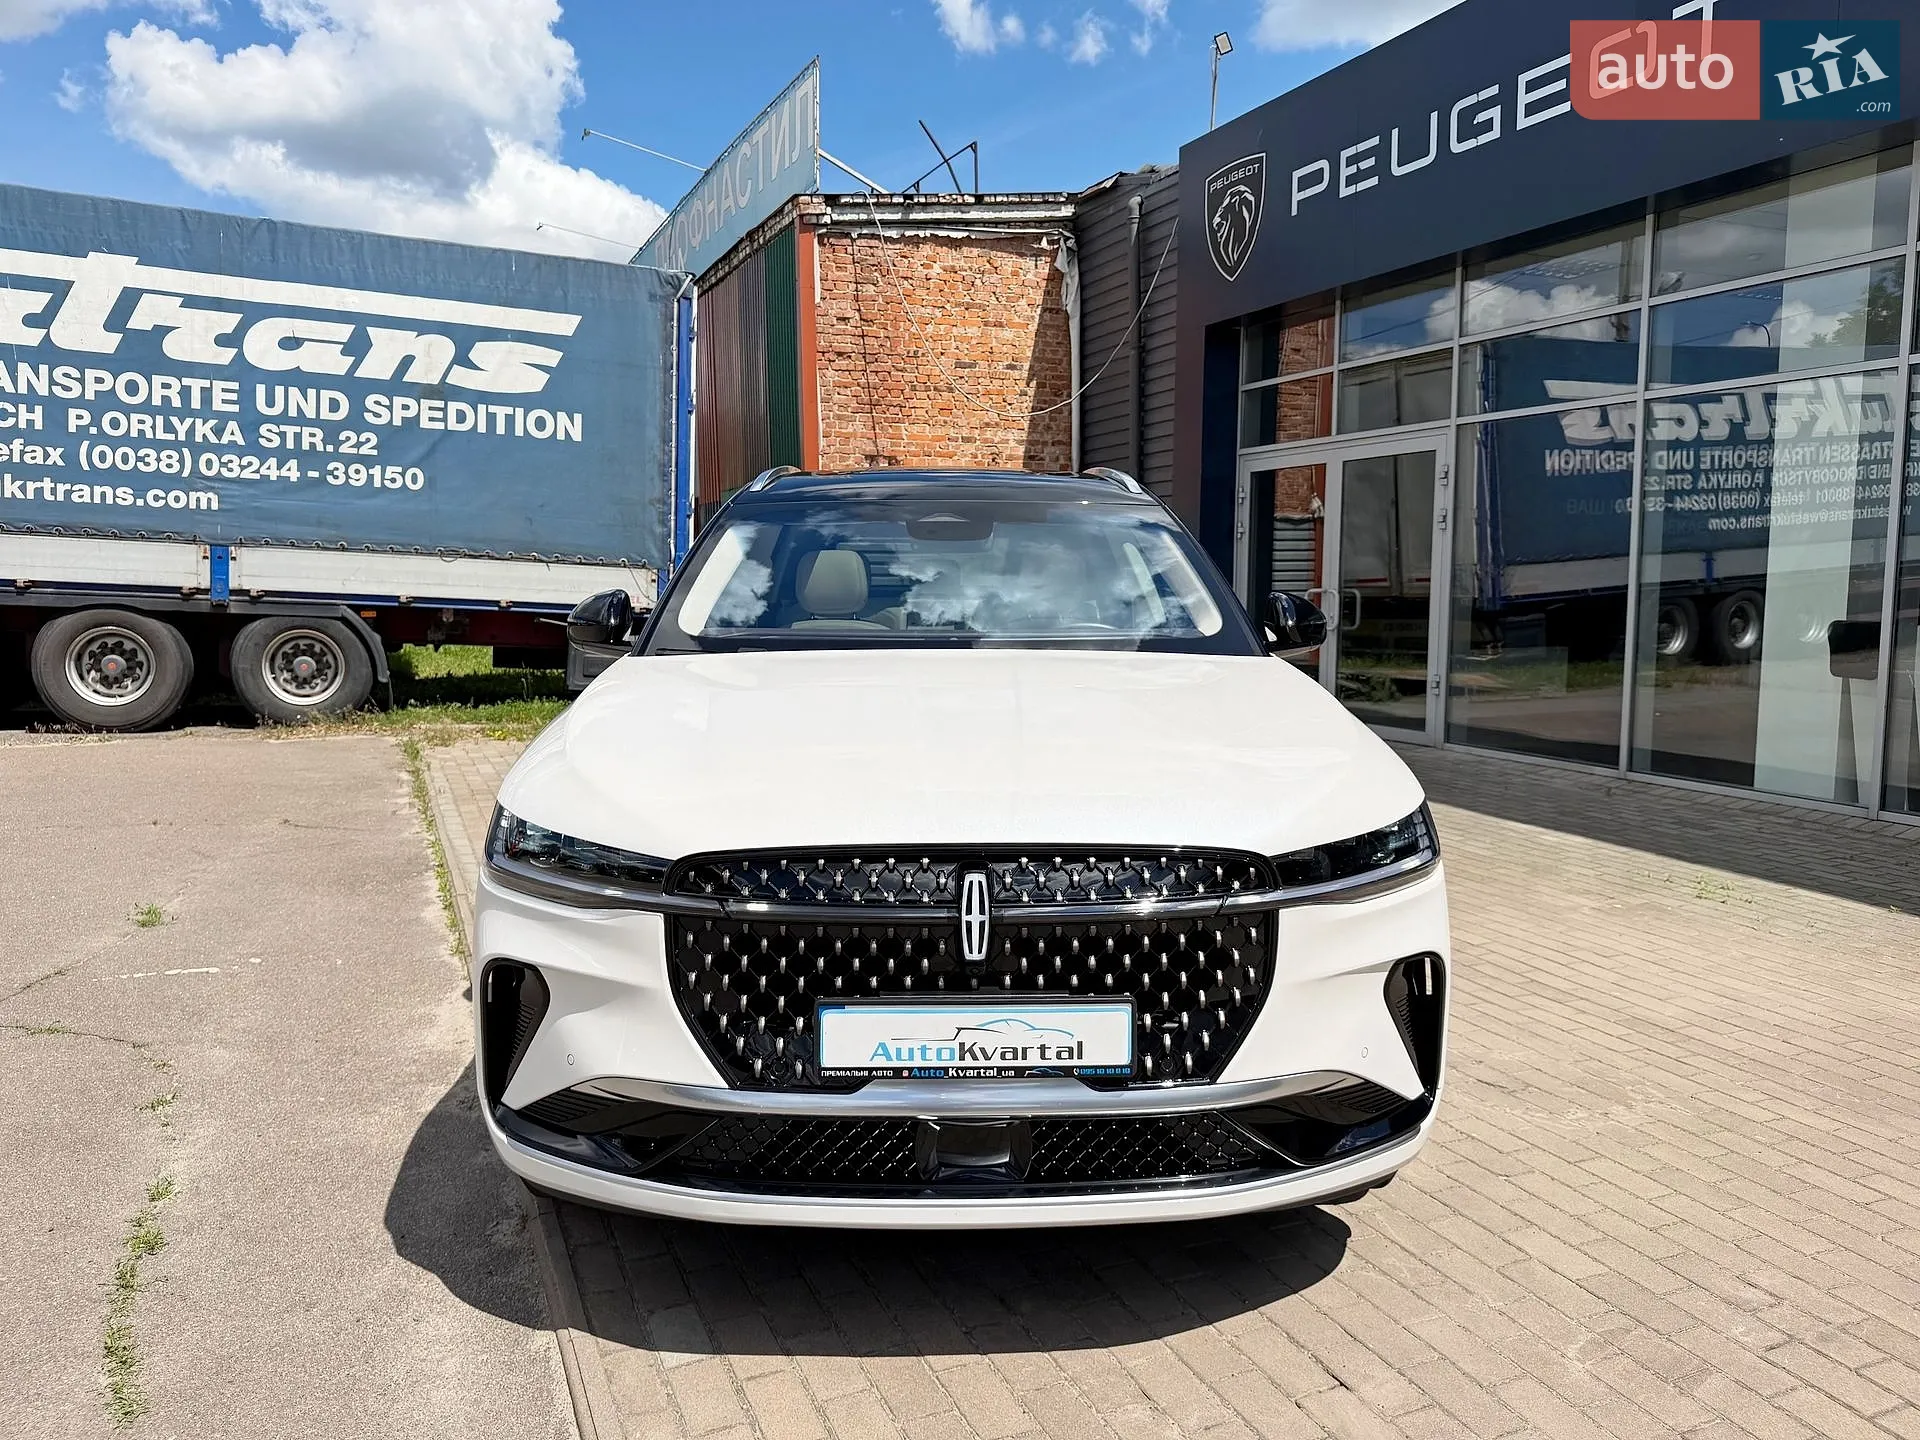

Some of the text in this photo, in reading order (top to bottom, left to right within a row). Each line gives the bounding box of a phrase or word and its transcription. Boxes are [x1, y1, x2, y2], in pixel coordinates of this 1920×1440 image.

[1290, 0, 1719, 216] PEUGEOT
[1210, 163, 1260, 193] PEUGEOT
[67, 408, 246, 445] P.ORLYKA
[258, 423, 379, 456] STR.22
[255, 384, 349, 421] UND
[363, 394, 582, 443] SPEDITION
[78, 440, 192, 477] (0038)
[869, 1041, 1083, 1062] AutoKvartal
